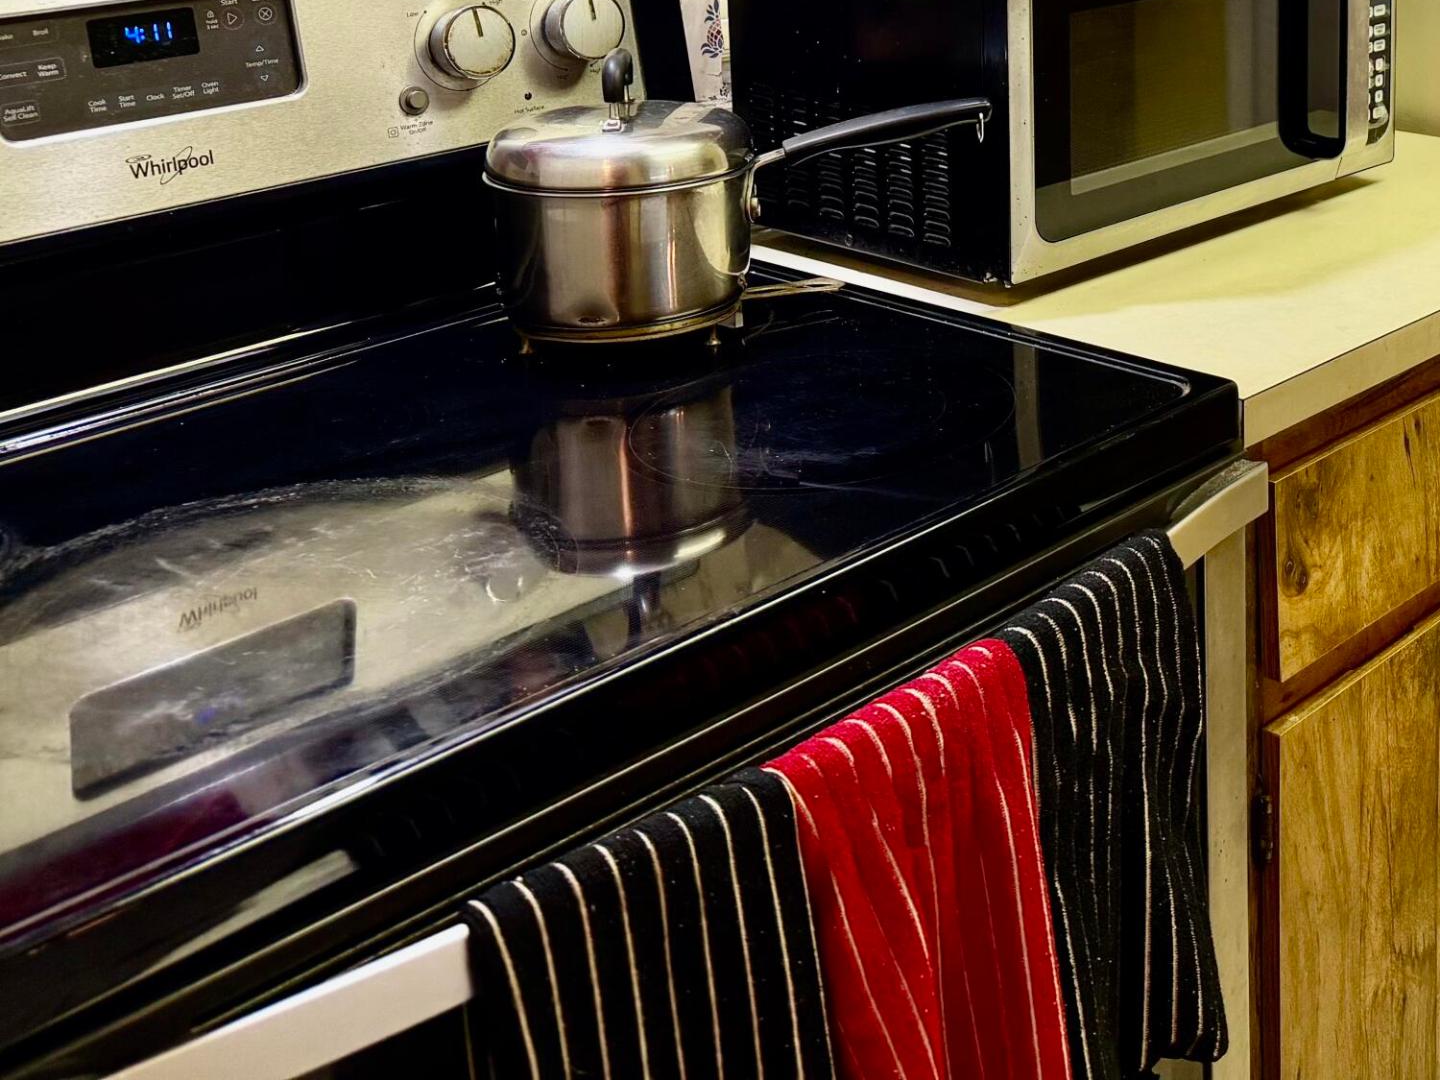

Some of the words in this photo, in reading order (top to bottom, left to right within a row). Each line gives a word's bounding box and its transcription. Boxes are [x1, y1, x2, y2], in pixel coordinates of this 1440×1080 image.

[124, 21, 173, 44] 4:11
[245, 59, 279, 68] Temp/Time
[201, 80, 219, 88] Oven
[172, 85, 192, 93] Timer
[202, 87, 220, 95] Light
[118, 94, 134, 102] Start
[146, 93, 165, 101] Clock
[88, 99, 106, 107] Cook
[129, 148, 215, 180] Whirlpool
